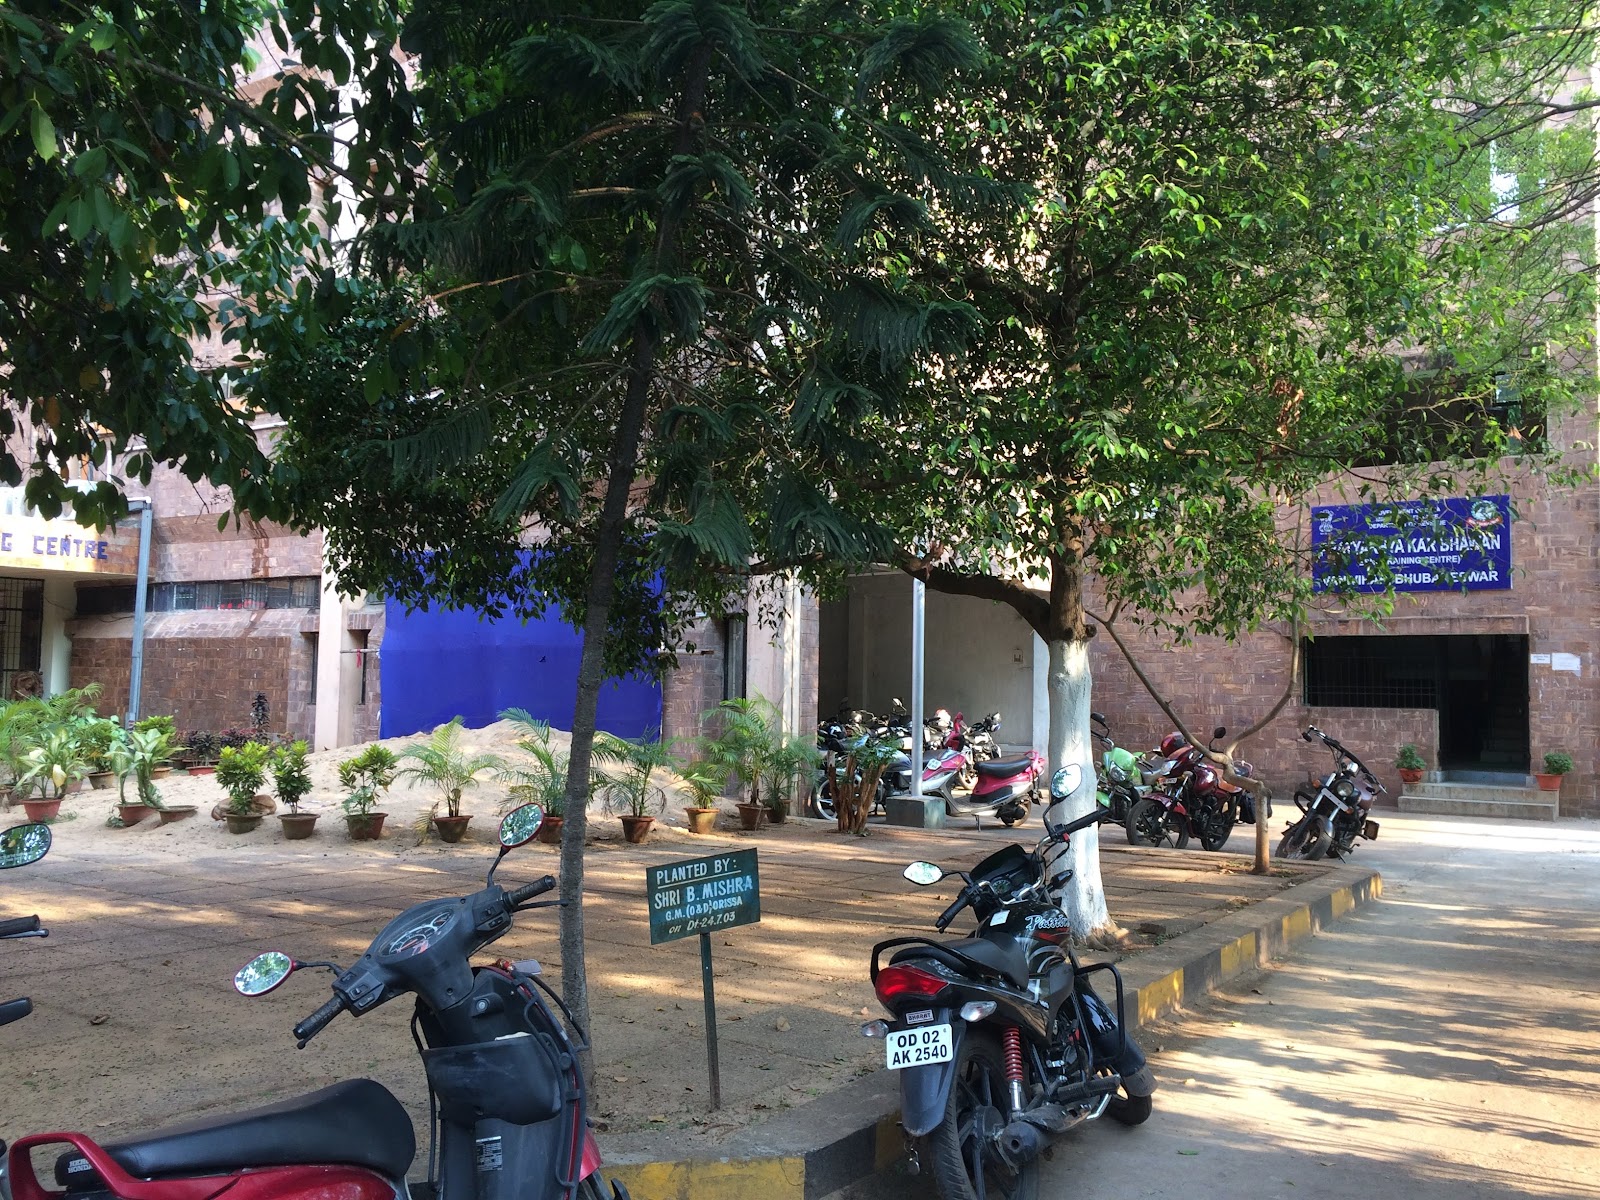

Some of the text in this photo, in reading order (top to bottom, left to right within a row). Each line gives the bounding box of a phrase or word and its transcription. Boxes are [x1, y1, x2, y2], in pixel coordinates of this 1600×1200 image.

[33, 535, 108, 559] CENTRE
[1395, 570, 1499, 585] BHUBAESWAR
[656, 862, 708, 885] PLANTED
[654, 888, 681, 910] SHRI
[668, 925, 682, 934] on
[897, 1030, 940, 1048] OD 02
[892, 1044, 948, 1066] AK 2540
